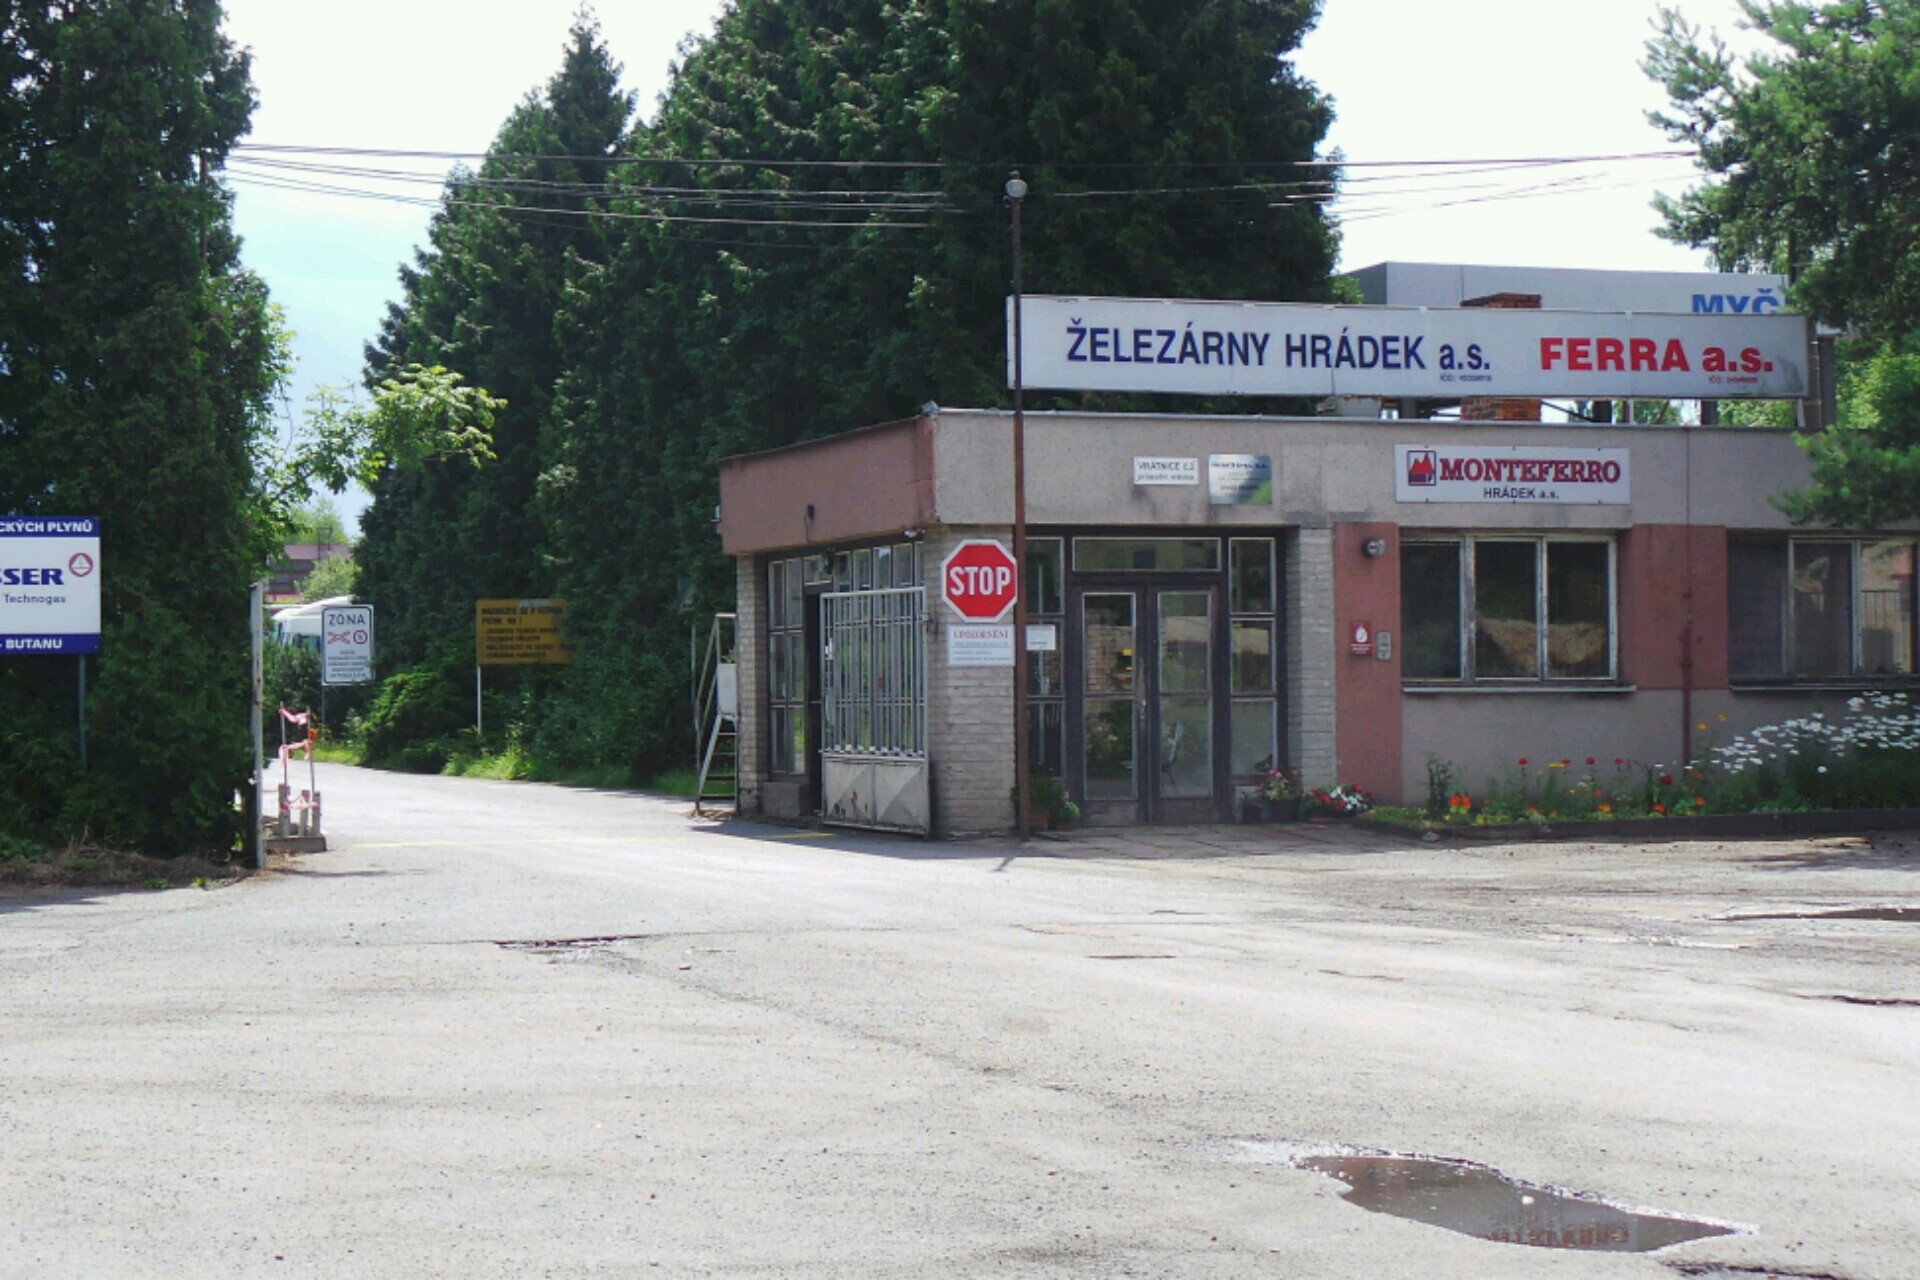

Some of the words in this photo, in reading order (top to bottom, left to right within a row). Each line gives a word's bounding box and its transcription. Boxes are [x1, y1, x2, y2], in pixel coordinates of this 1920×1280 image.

[1066, 317, 1270, 366] ŽELEZÁRNY
[1285, 327, 1427, 370] HRÁDEK
[1439, 343, 1491, 370] a.s.
[1540, 337, 1690, 372] FERRA
[1702, 346, 1774, 373] a.s.
[1439, 458, 1621, 483] MONTEFERRO
[1483, 487, 1536, 499] HRÁDEK
[47, 519, 93, 532] PLYNŮ
[0, 568, 64, 586] SER
[950, 566, 1011, 595] STOP
[4, 594, 66, 605] Technogas
[5, 639, 62, 649] BUTANU
